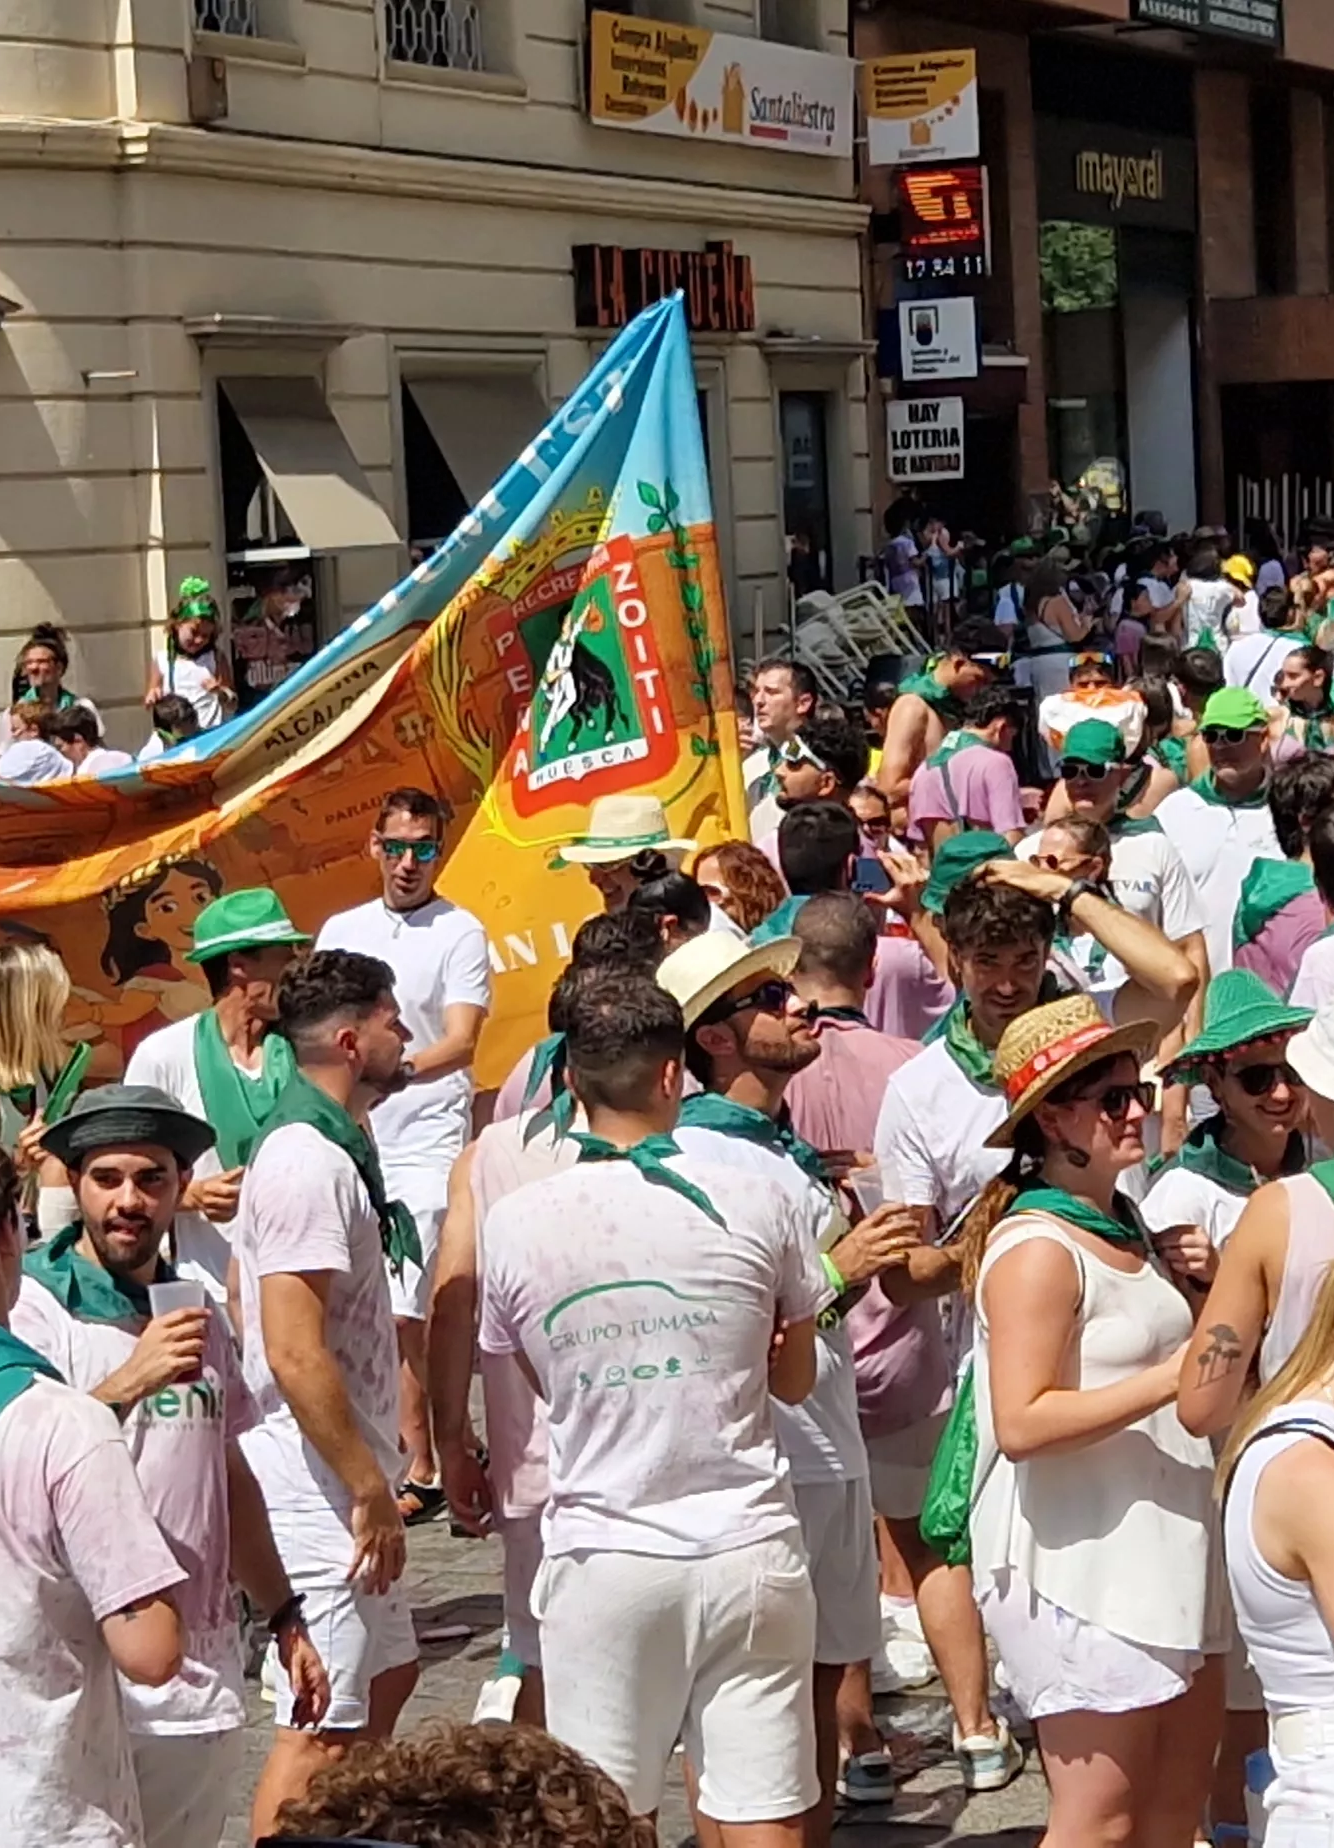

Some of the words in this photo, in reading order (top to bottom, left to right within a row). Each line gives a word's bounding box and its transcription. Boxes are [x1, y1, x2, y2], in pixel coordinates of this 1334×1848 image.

[610, 20, 651, 53] Compra
[750, 86, 836, 132] Santaliestra
[1075, 148, 1163, 211] mayoral
[908, 403, 941, 424] HAY
[612, 561, 665, 736] ZOITI
[535, 745, 634, 785] HUESCA
[548, 1324, 622, 1351] GRUPO
[627, 1310, 719, 1337] TUMASA
